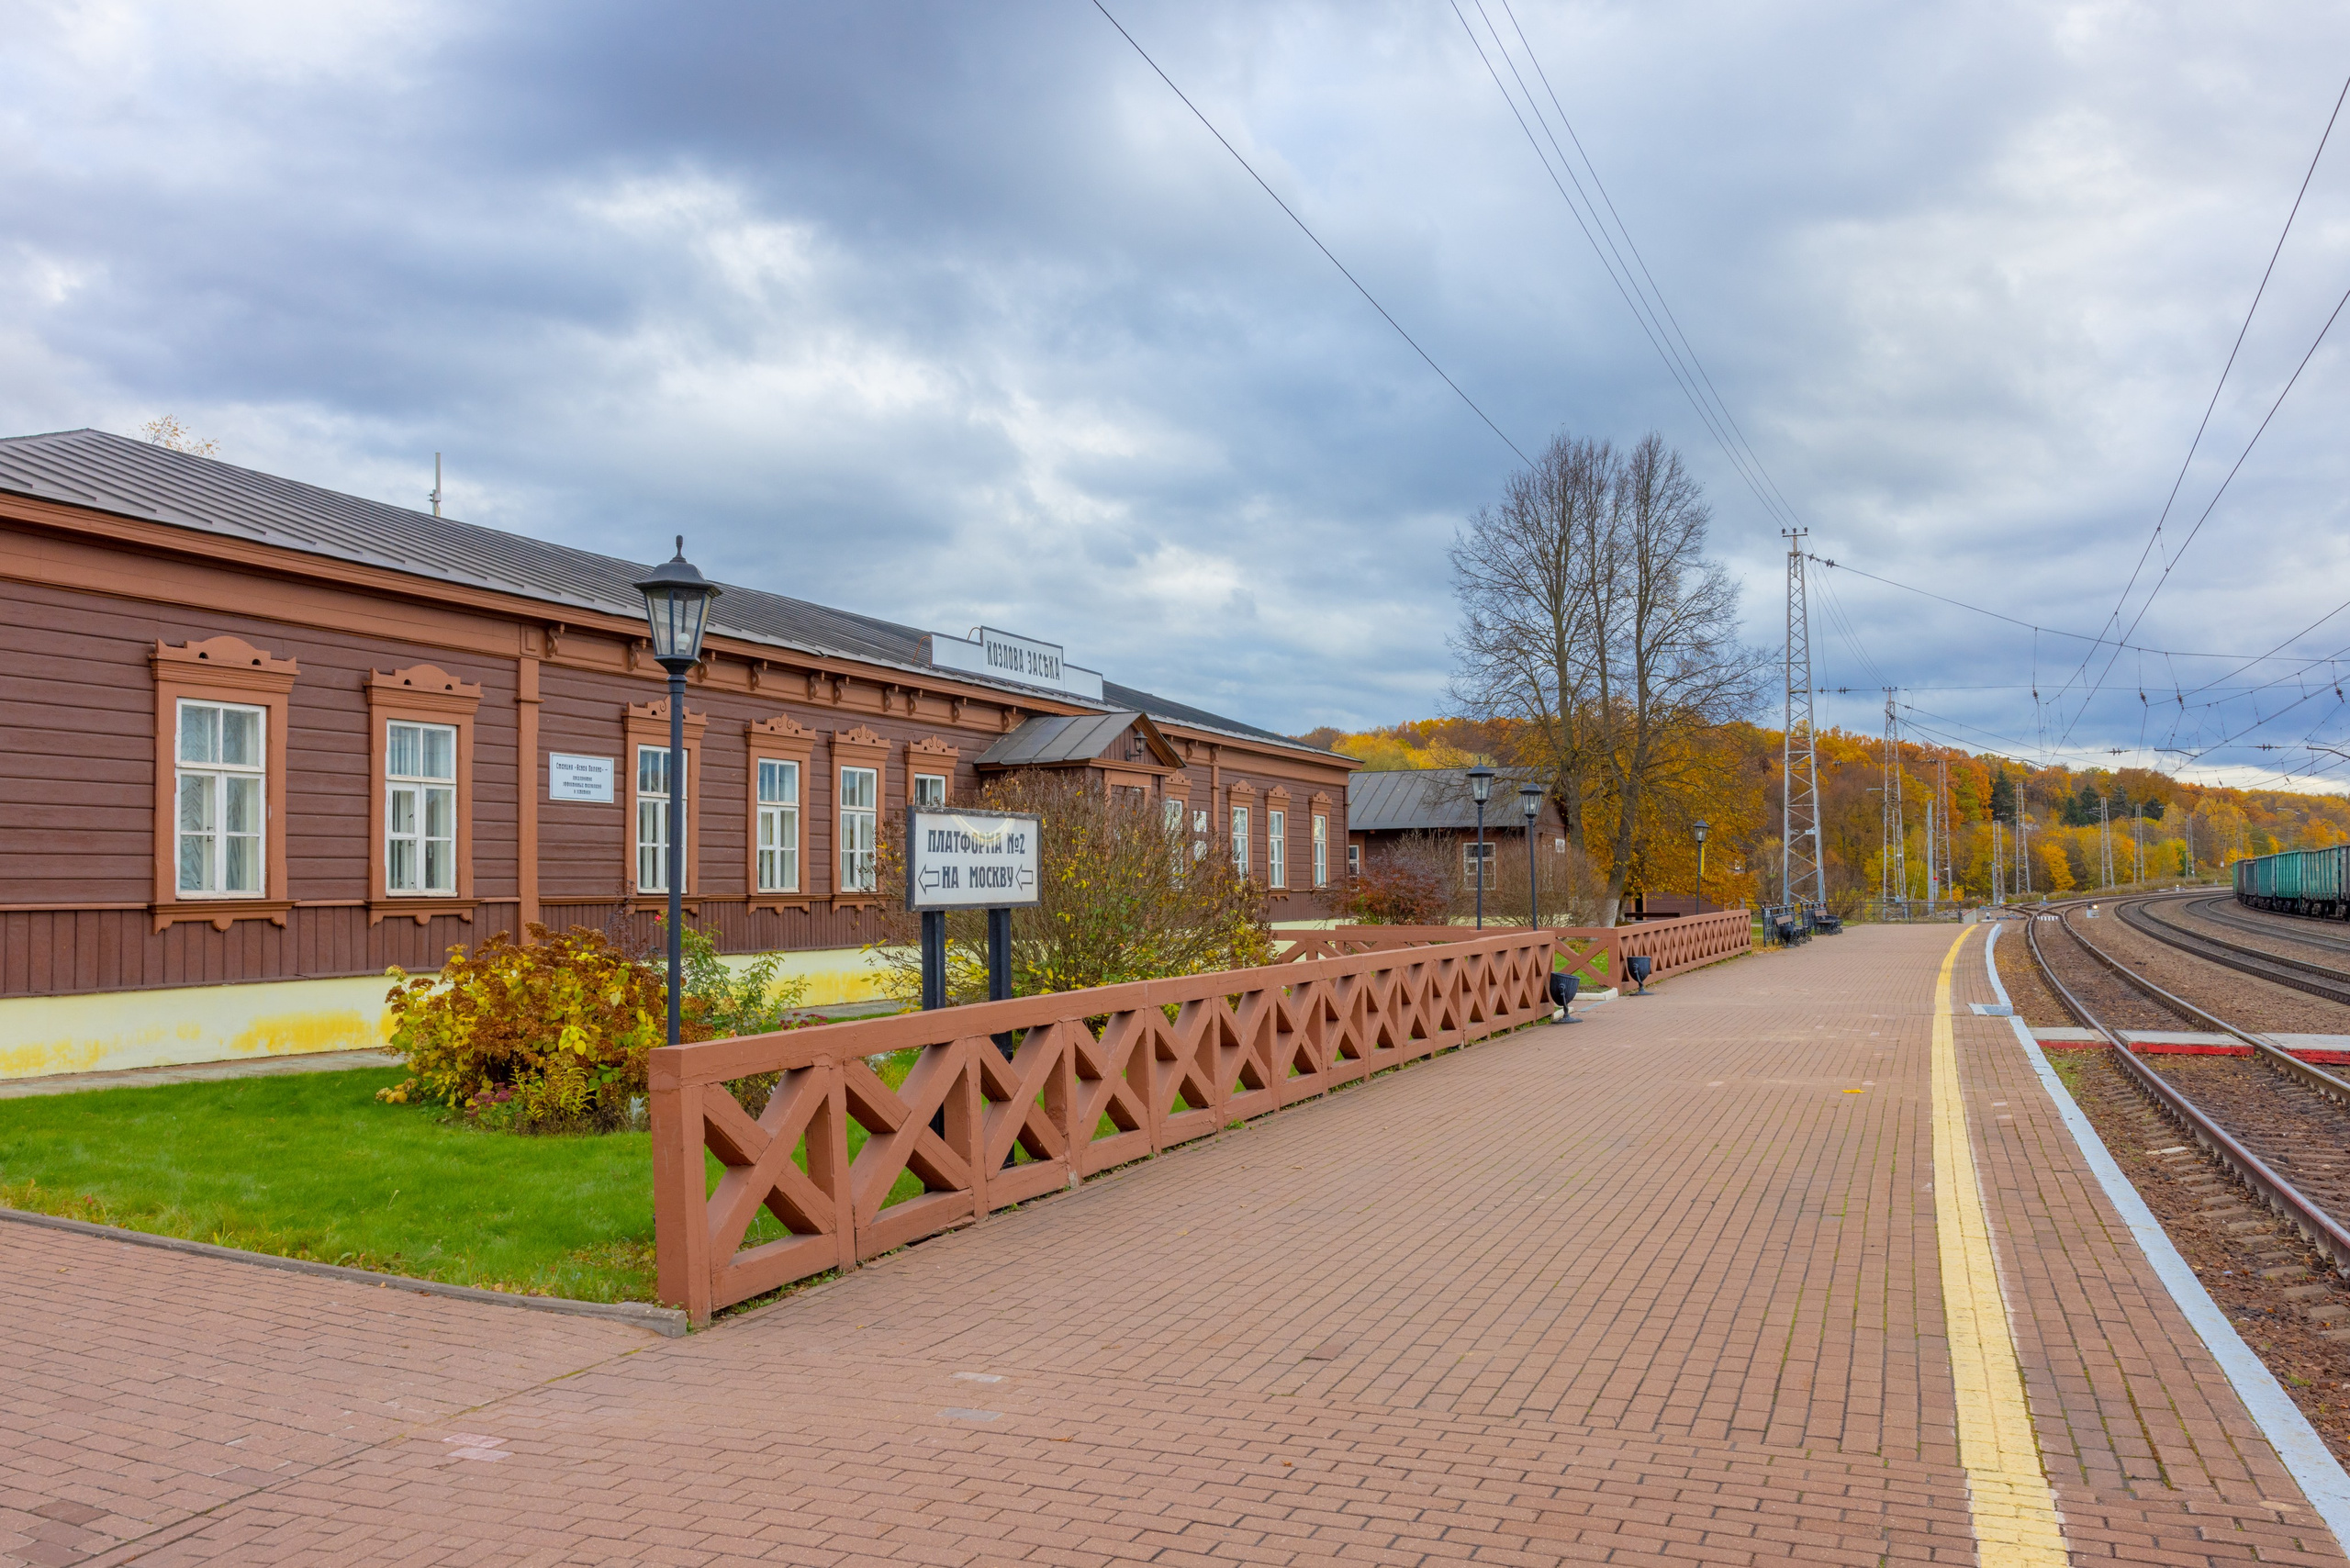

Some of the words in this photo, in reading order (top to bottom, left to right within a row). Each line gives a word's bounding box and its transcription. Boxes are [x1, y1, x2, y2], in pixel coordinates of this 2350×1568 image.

[987, 640, 1024, 673] КОЗЛОВА
[927, 829, 1002, 855] ПЛАТФОРМА
[1006, 832, 1026, 855] №2
[942, 866, 960, 889] НА
[968, 866, 1014, 889] МОСКВУ
